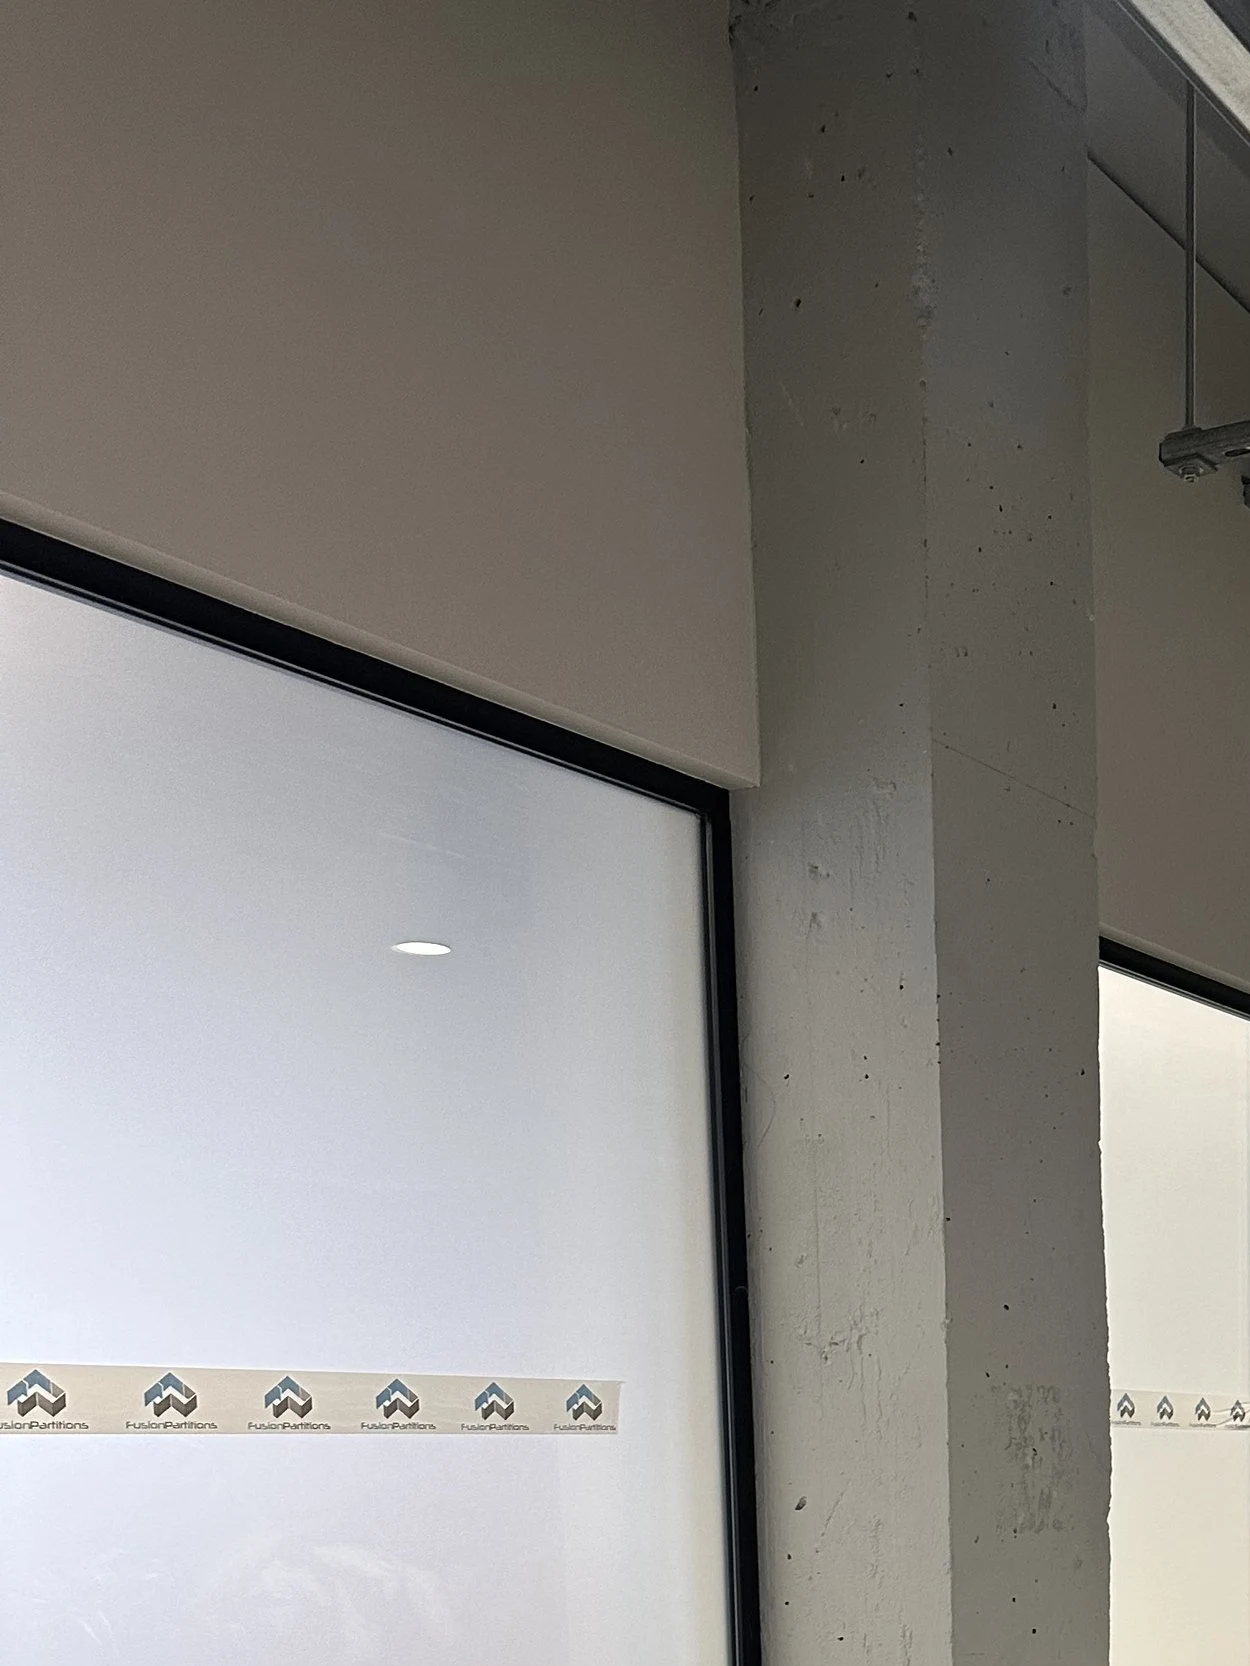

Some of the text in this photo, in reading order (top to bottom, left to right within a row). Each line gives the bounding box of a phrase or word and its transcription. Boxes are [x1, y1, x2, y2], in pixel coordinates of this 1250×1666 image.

[0, 1420, 89, 1431] sionPartitions
[125, 1421, 218, 1431] FusionPartitions
[248, 1421, 332, 1431] FusionPartitions
[360, 1421, 437, 1431] FusionPartitions
[461, 1422, 530, 1432] FusionPartitions
